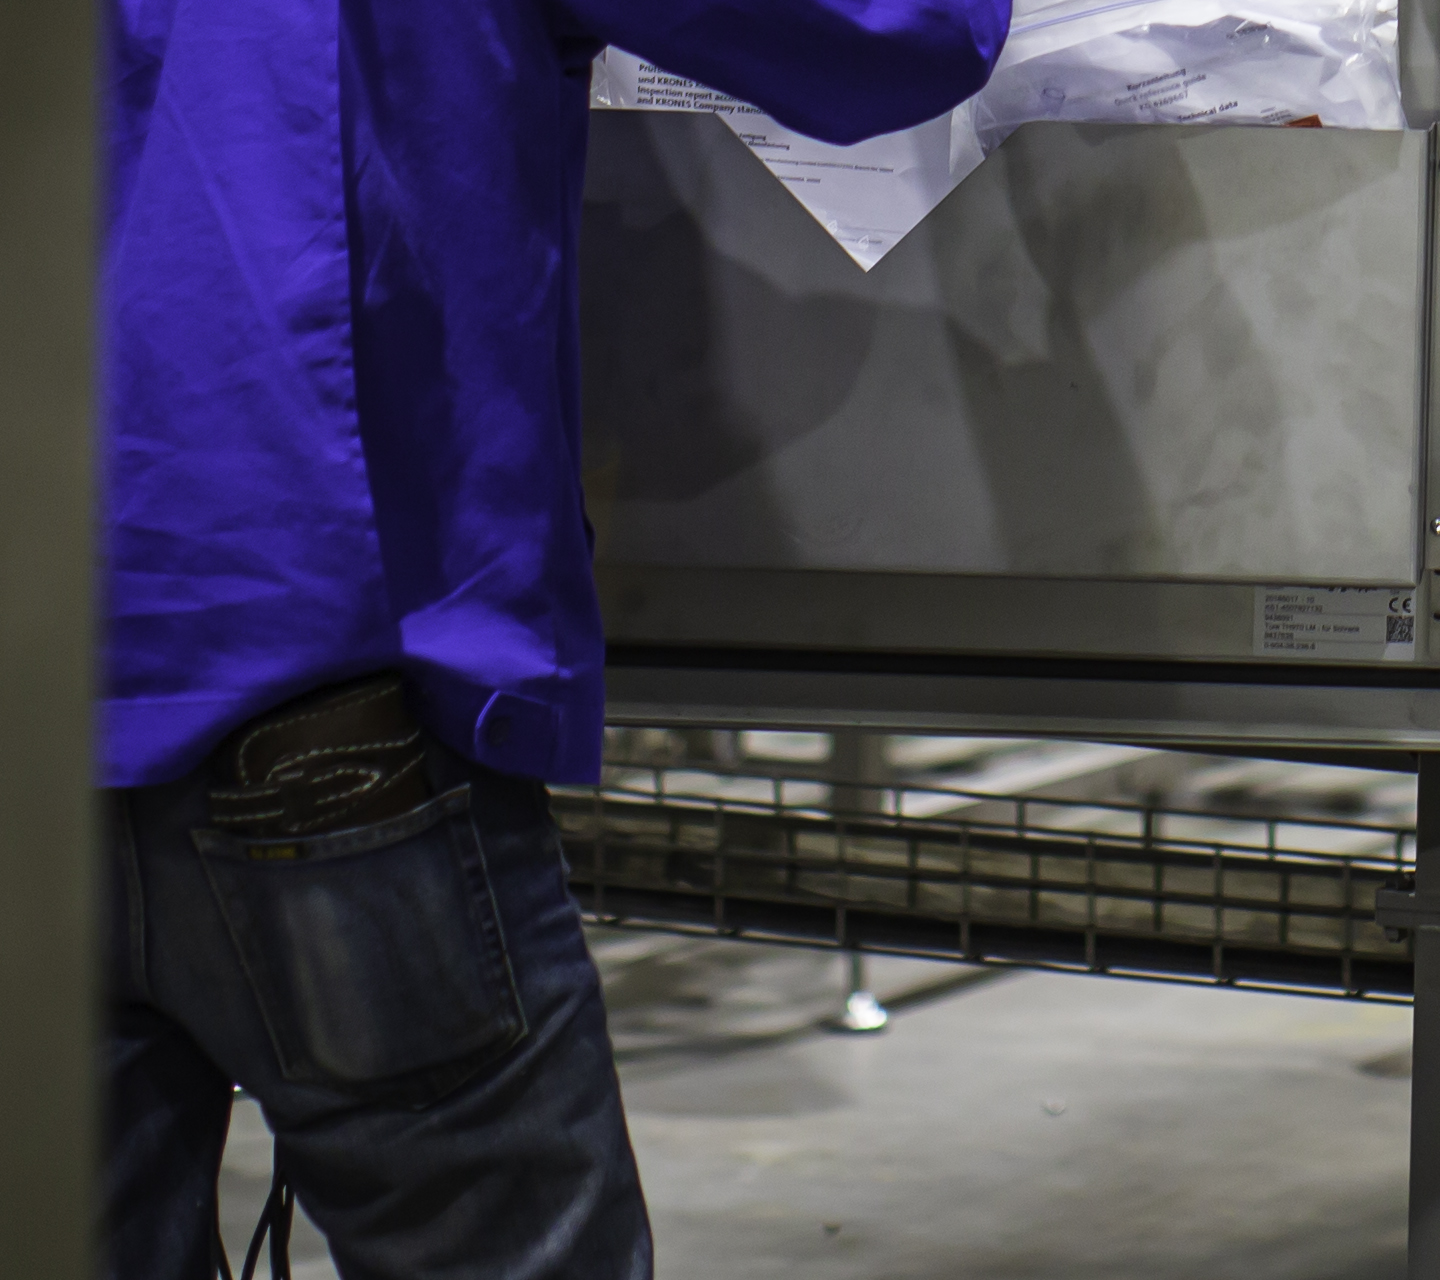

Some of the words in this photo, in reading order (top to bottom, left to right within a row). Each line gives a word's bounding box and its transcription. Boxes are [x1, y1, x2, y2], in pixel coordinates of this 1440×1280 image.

[638, 75, 655, 85] und
[657, 76, 694, 88] KRONES
[637, 85, 683, 98] Inspection
[685, 91, 712, 101] report
[636, 96, 654, 105] and
[655, 97, 692, 108] KRONES
[693, 100, 736, 115] Company
